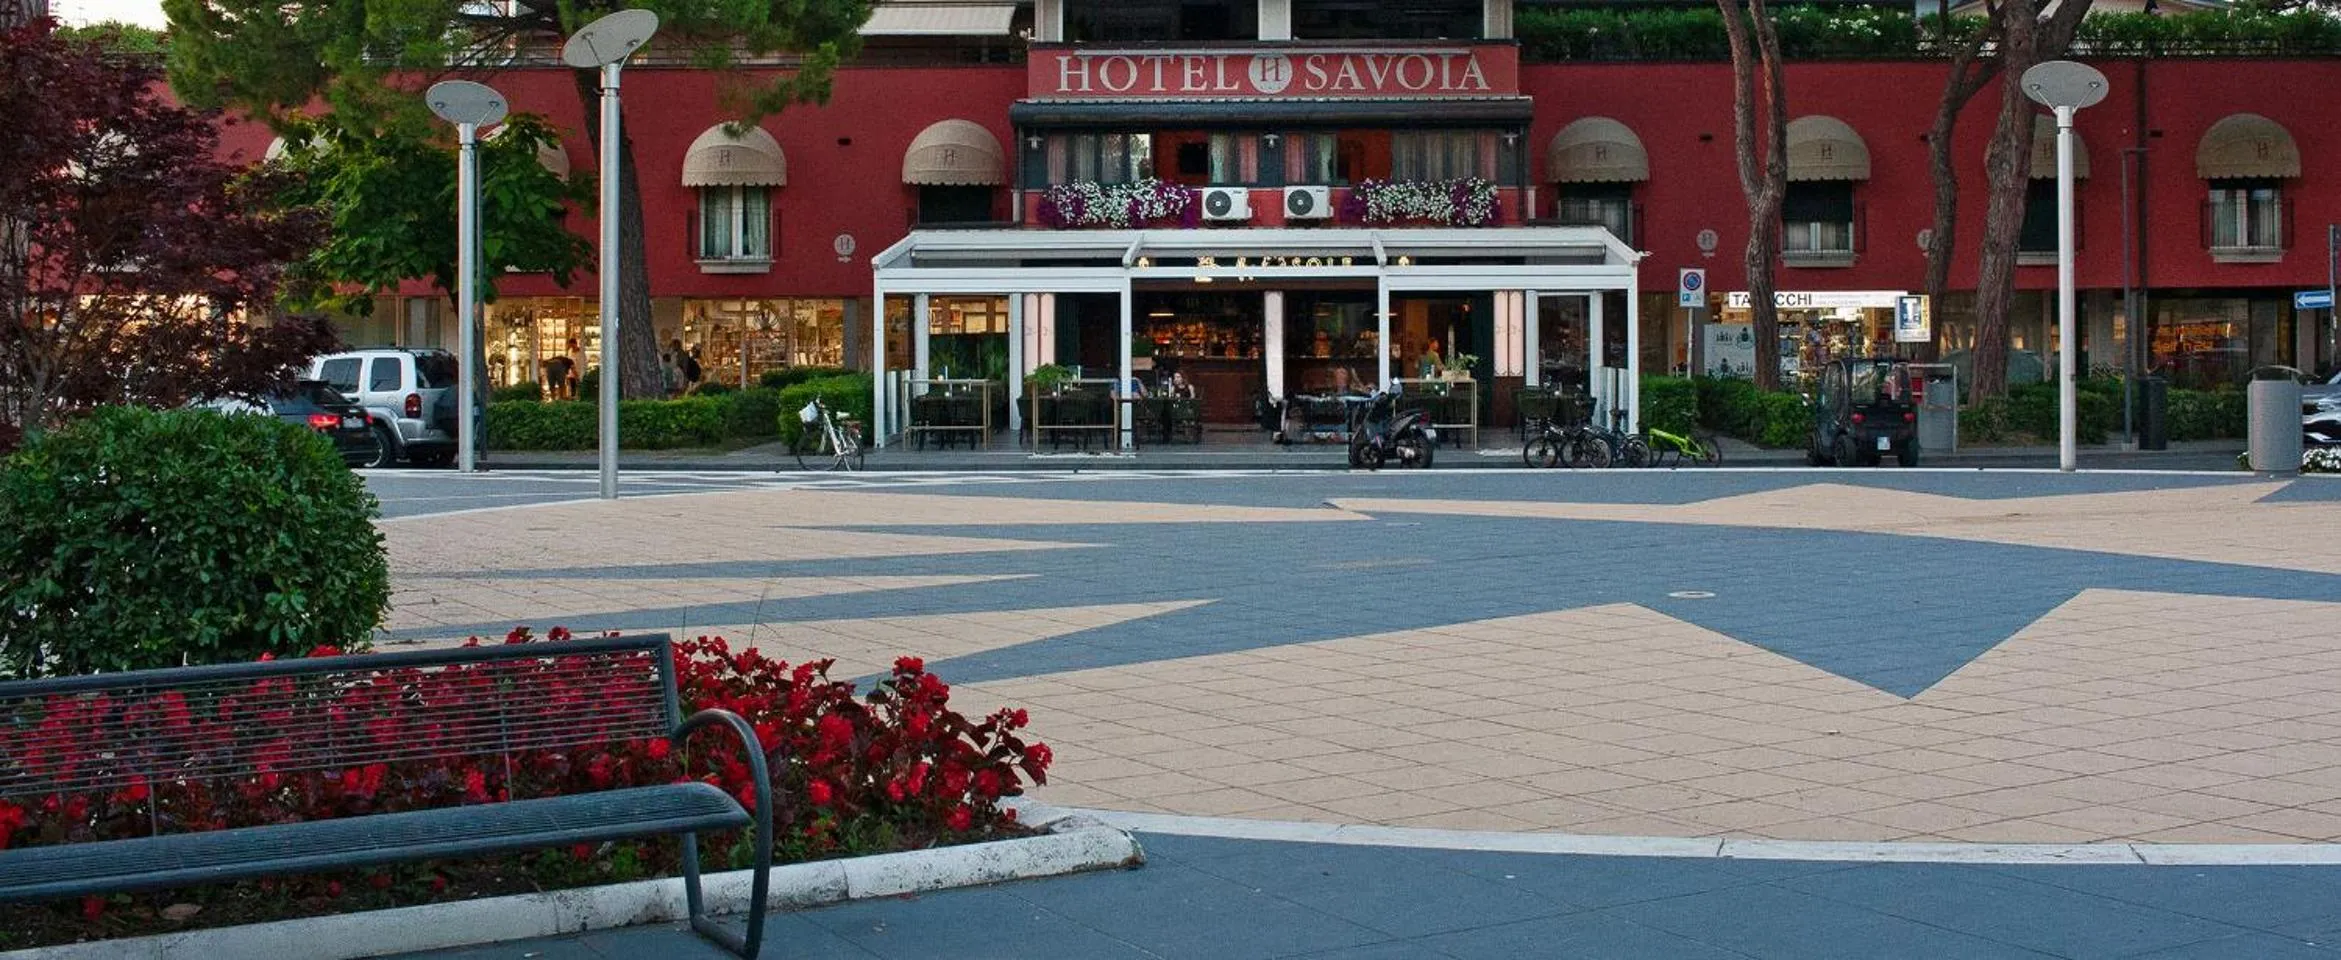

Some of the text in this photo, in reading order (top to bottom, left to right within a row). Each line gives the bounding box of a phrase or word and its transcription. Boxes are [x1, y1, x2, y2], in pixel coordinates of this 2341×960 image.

[1055, 55, 1241, 92] HOTEL
[1304, 54, 1492, 91] SAVOIA
[1733, 293, 1812, 306] TACCHI
